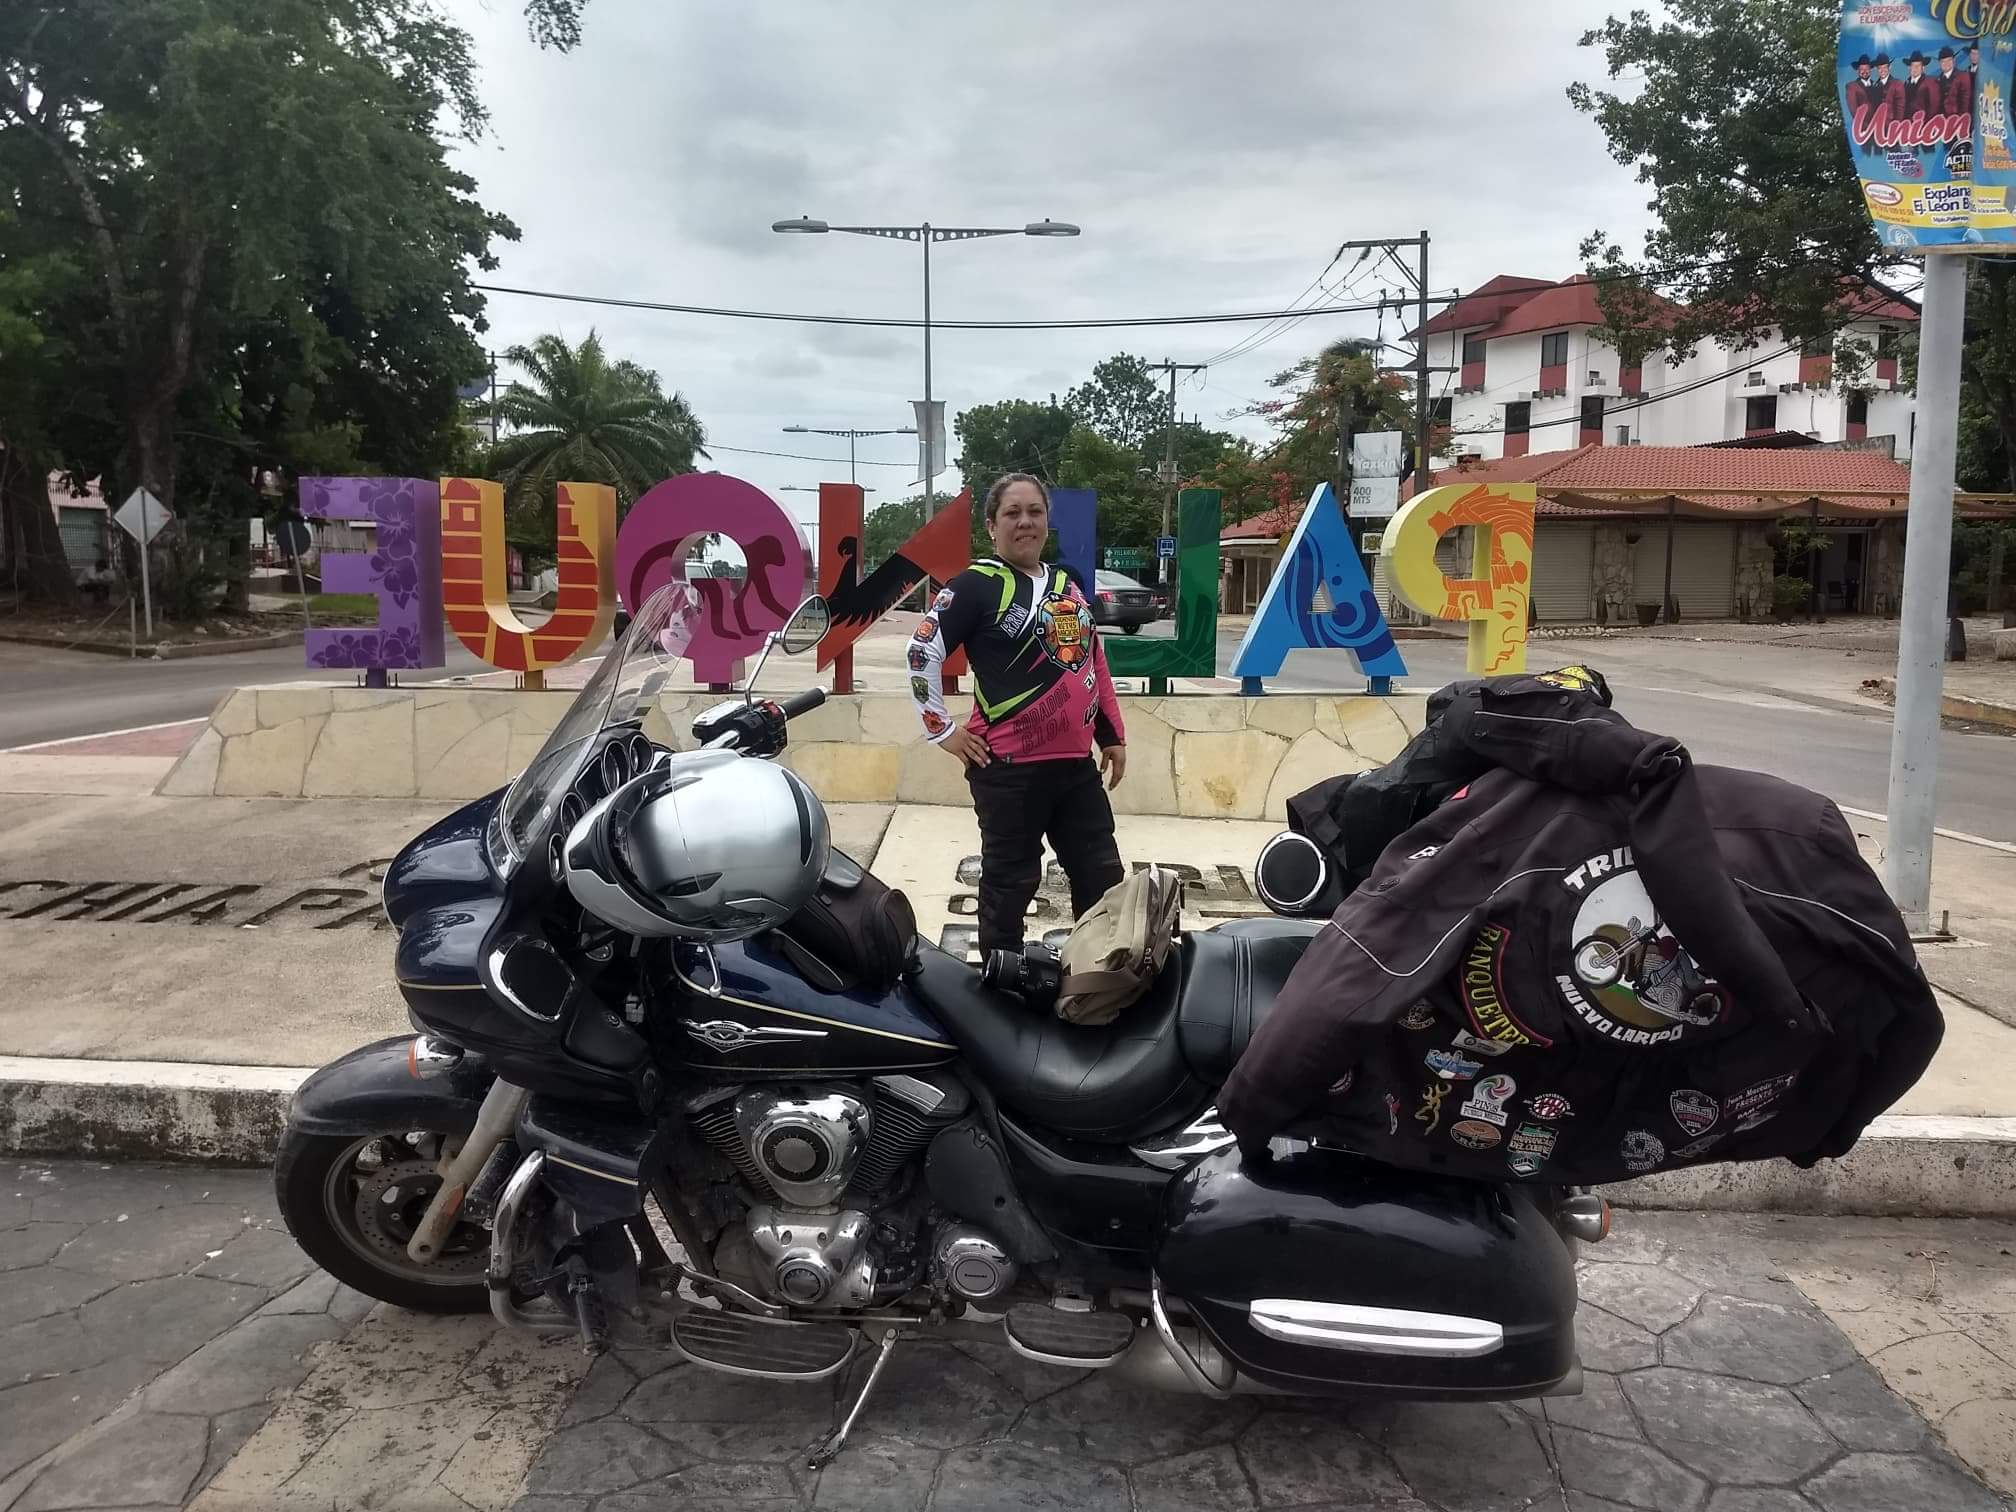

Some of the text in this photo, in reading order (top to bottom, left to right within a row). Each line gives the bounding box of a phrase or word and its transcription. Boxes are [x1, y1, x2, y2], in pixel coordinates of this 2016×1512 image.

[1928, 197, 1962, 212] León
[1353, 486, 1372, 497] 400
[1353, 496, 1371, 505] MTS
[1555, 974, 1614, 1034] NUEVO
